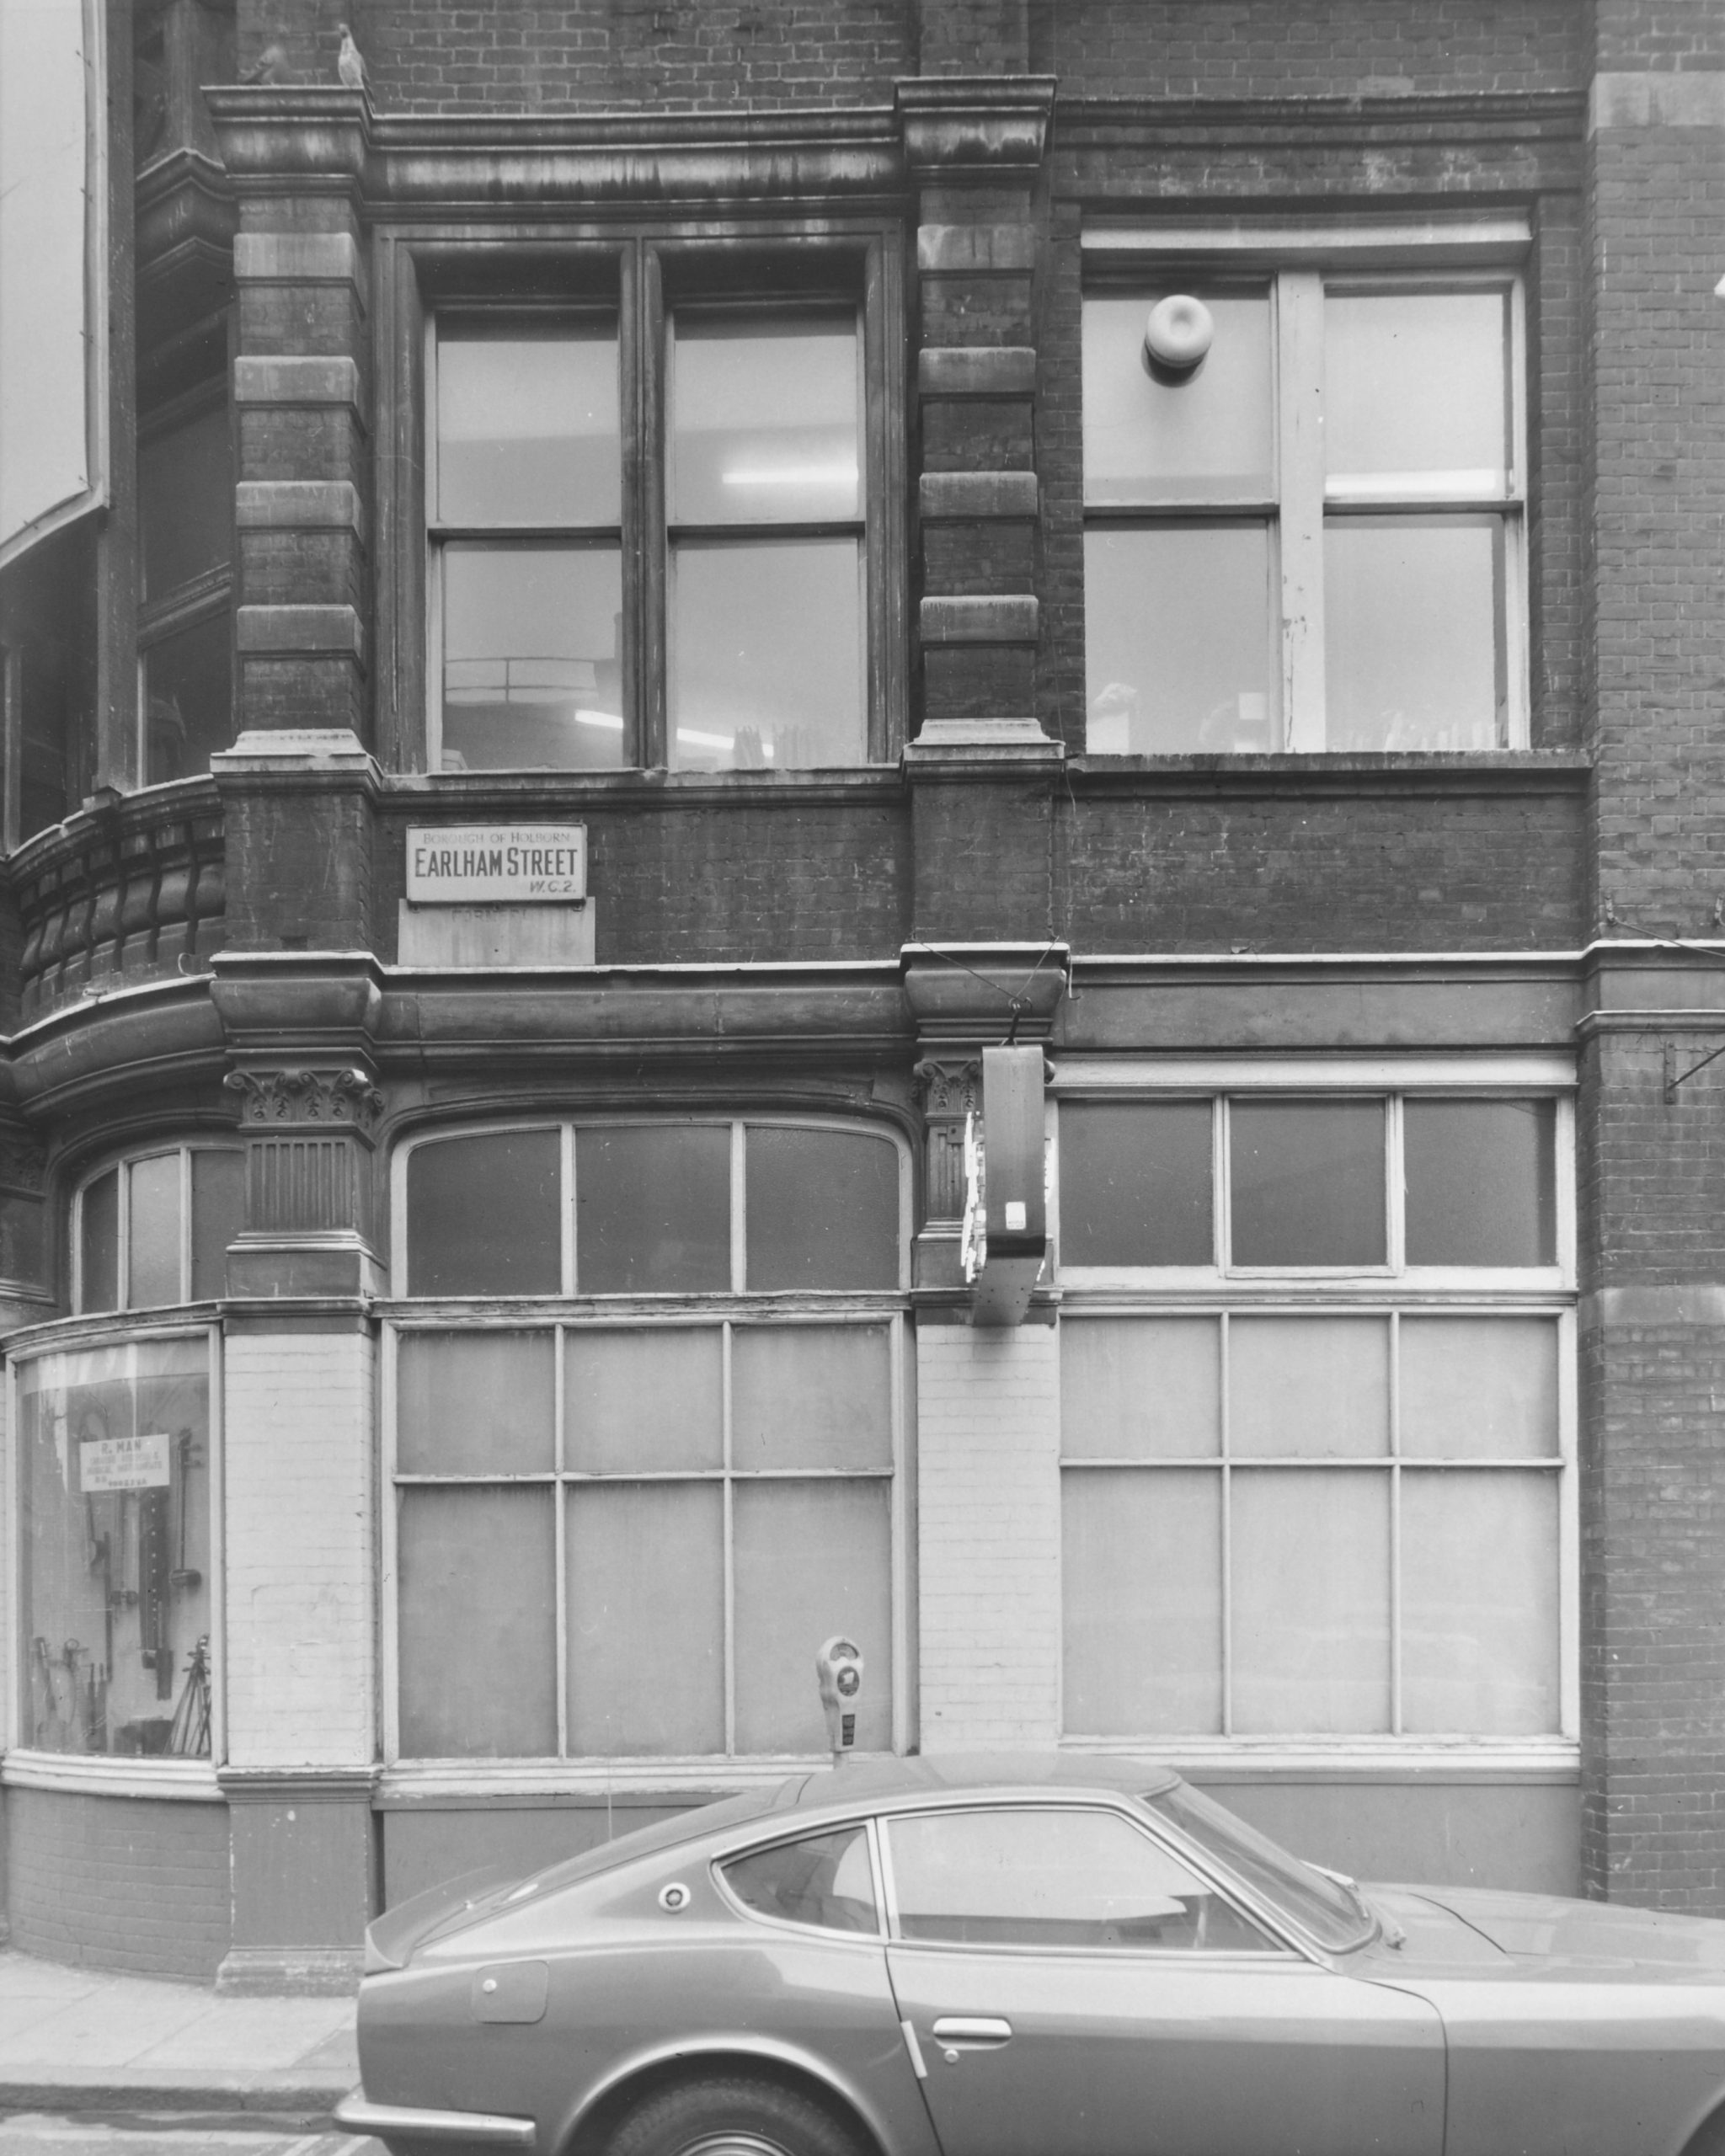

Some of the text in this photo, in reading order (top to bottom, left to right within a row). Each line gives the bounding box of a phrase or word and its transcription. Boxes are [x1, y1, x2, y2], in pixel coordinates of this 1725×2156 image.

[424, 832, 570, 844] BOROUGH OF HOLBORN
[415, 846, 578, 878] EARLHAM STREET
[530, 880, 576, 894] W.C.2.
[116, 1438, 142, 1454] MAN
